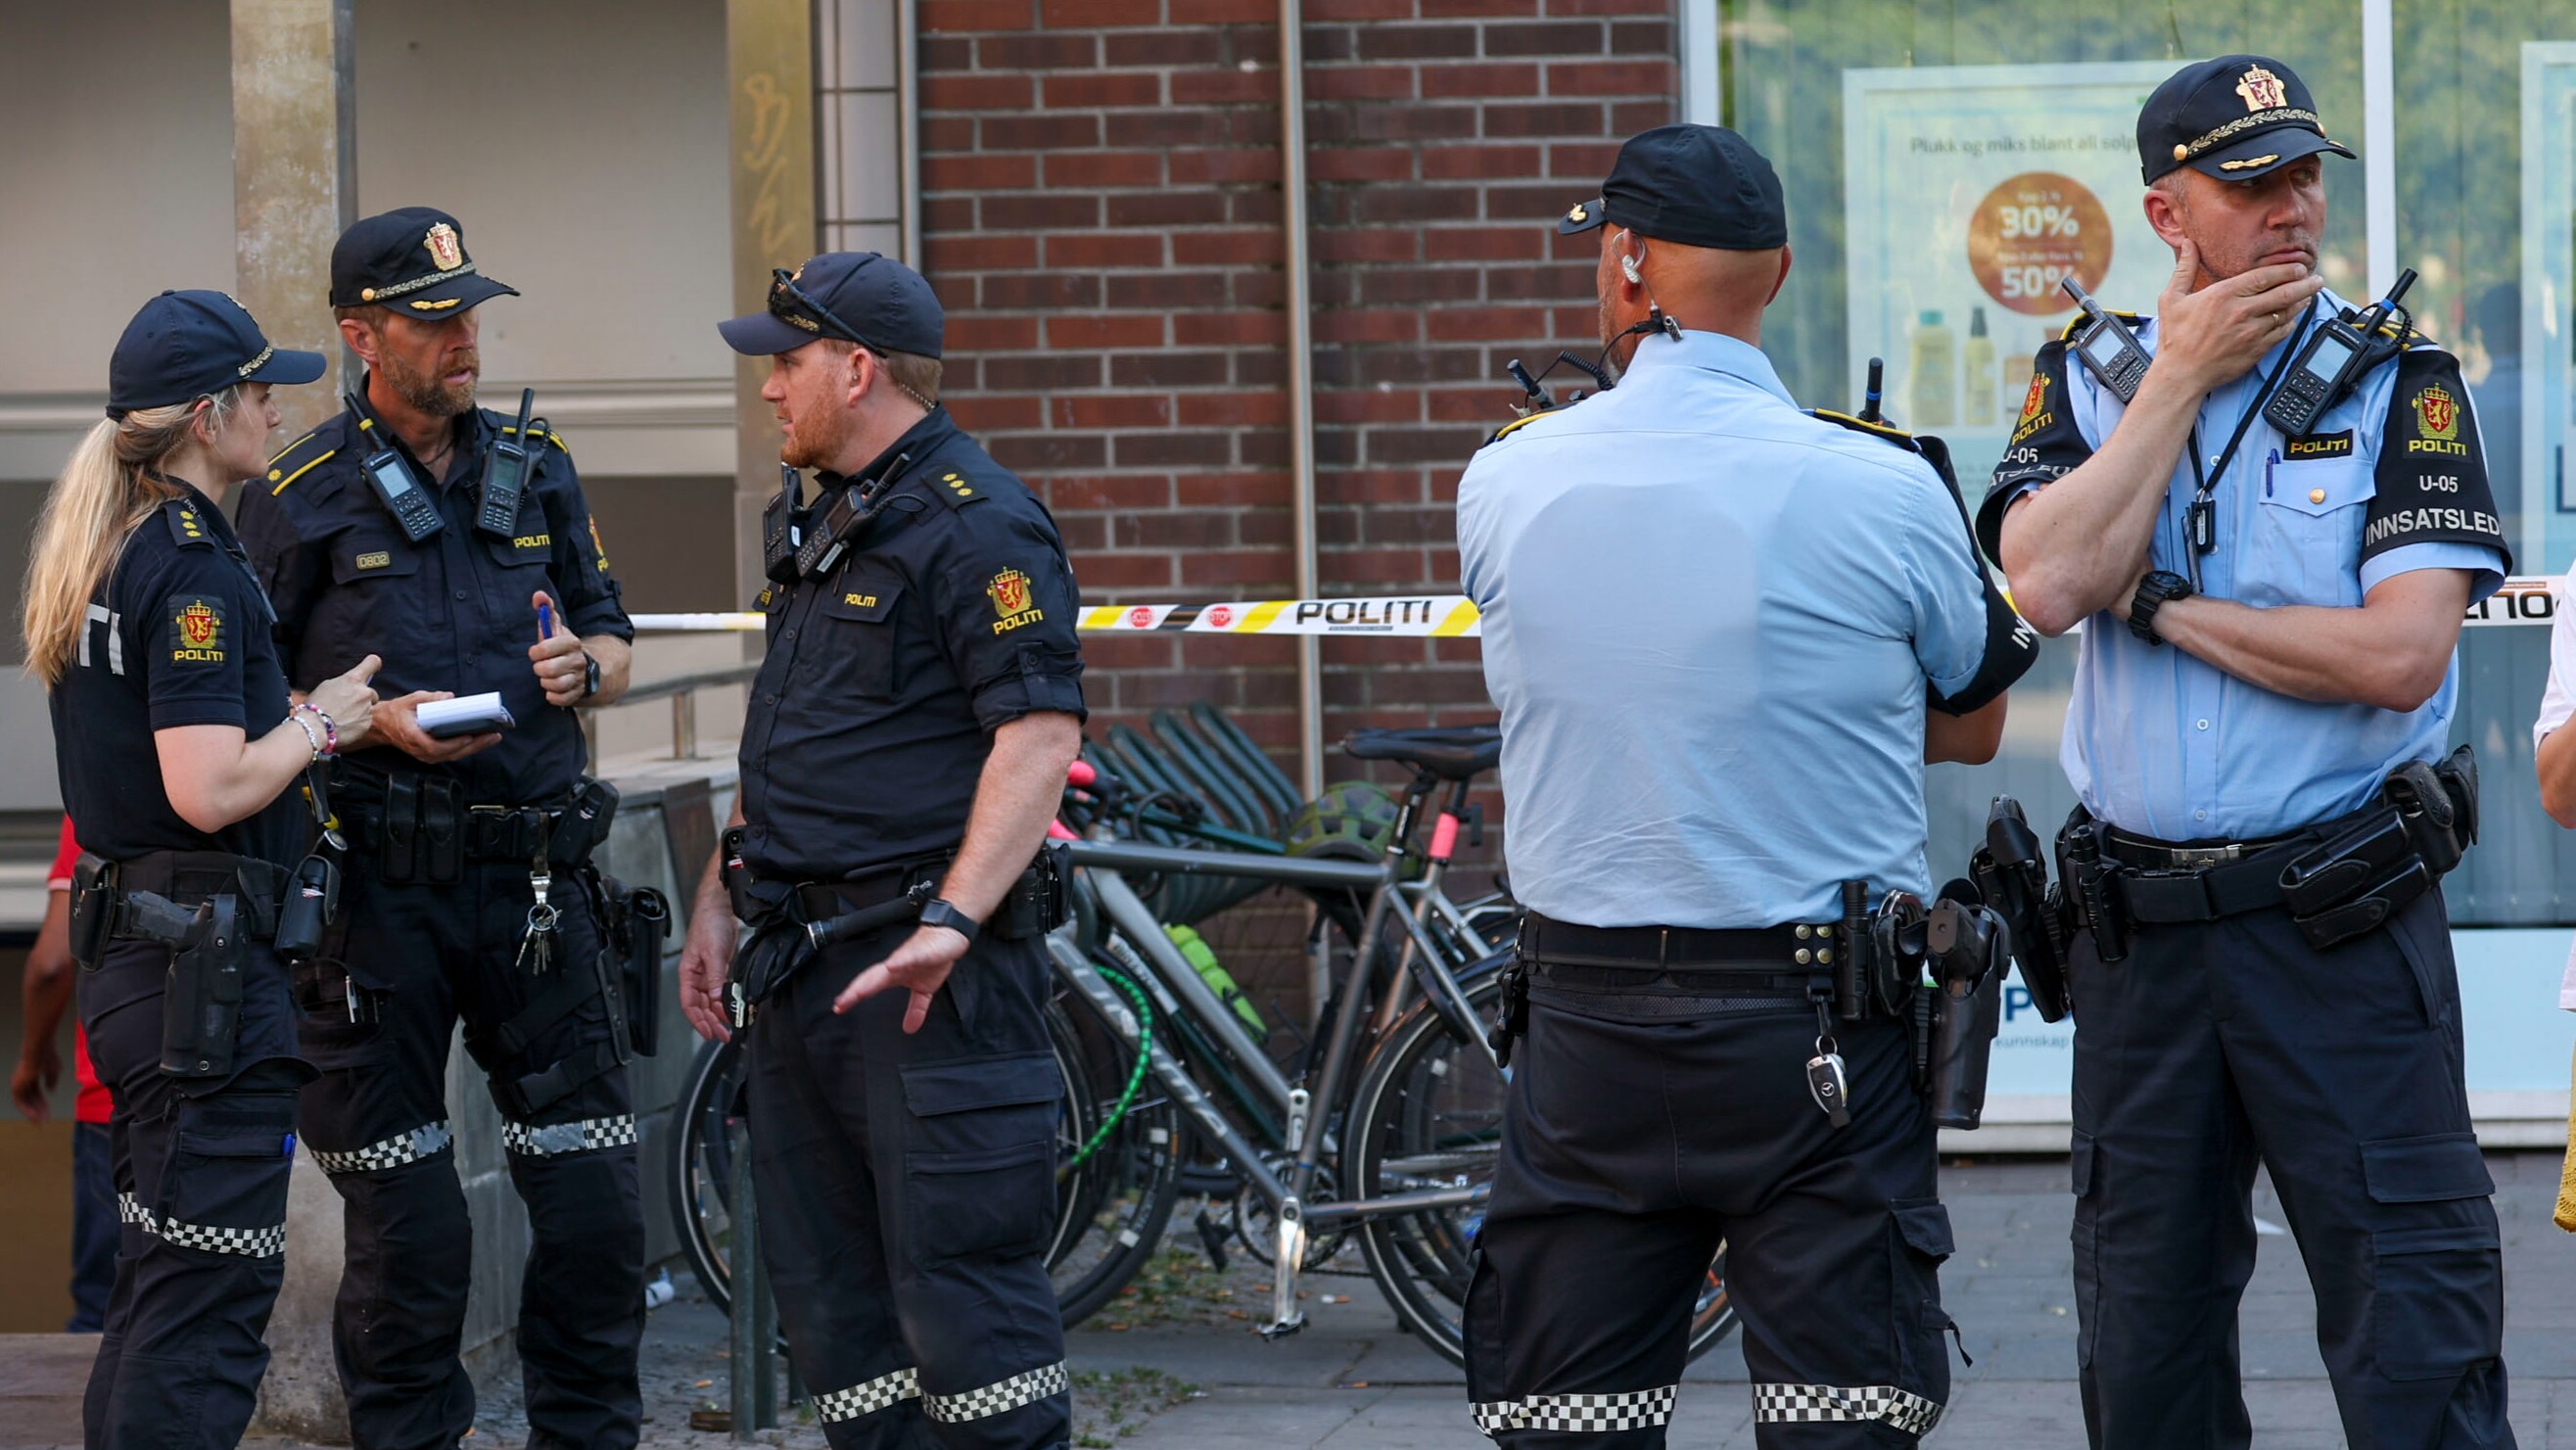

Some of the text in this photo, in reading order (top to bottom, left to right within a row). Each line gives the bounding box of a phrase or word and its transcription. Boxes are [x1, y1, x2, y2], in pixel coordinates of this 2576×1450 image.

[1961, 140, 1981, 157] og
[1987, 135, 2024, 152] miks
[2030, 134, 2071, 152] blant
[1999, 205, 2080, 238] 30%
[2001, 264, 2074, 298] 50%
[2011, 412, 2053, 445] POLITI
[2289, 439, 2348, 453] POLITI
[2408, 440, 2467, 456] POLITI
[2418, 475, 2459, 493] U-05
[513, 534, 550, 548] POLITI
[844, 592, 877, 608] POLITI
[992, 608, 1045, 635] POLITI
[1296, 600, 1432, 625] POLITI
[173, 649, 224, 662] POLITI
